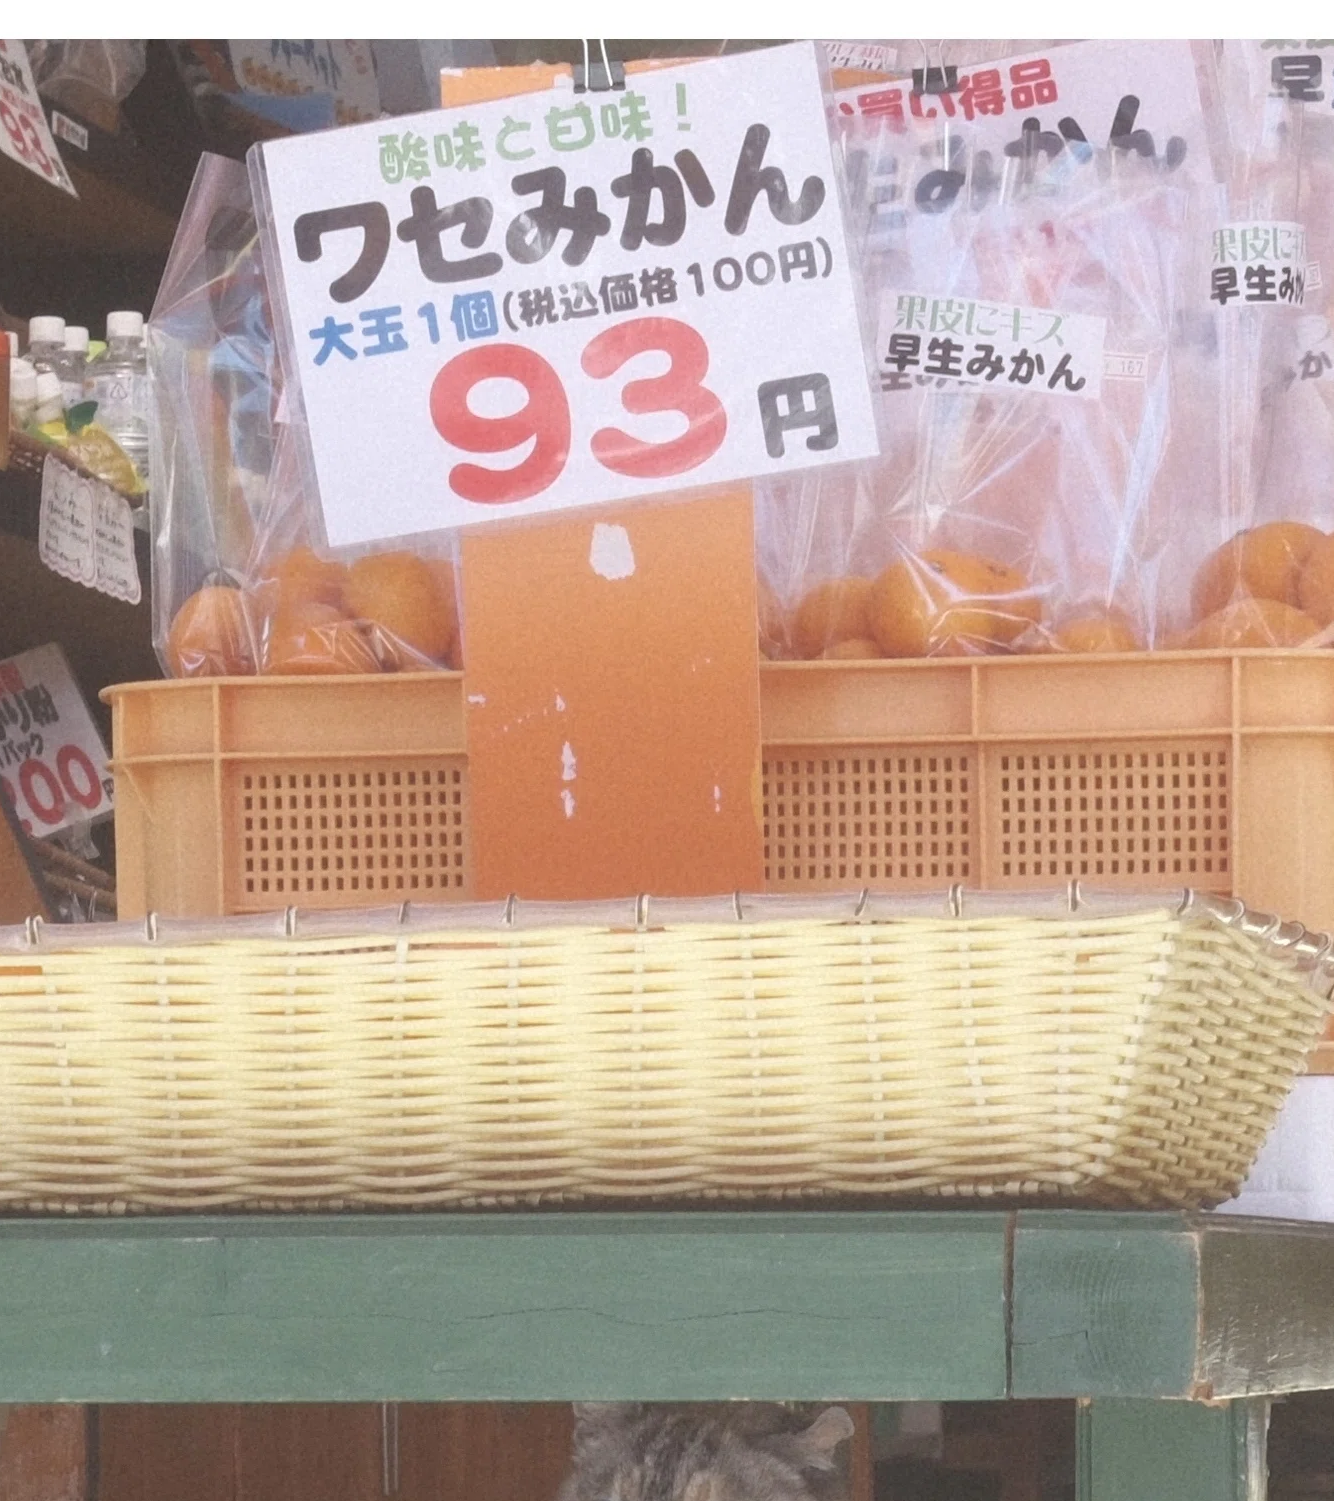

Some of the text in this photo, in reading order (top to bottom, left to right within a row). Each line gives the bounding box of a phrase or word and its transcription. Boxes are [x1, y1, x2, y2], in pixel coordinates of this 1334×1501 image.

[293, 123, 827, 303] ワセみかん
[428, 315, 728, 505] 93
[883, 332, 1087, 392] 早生みかん
[3, 743, 103, 836] 00
